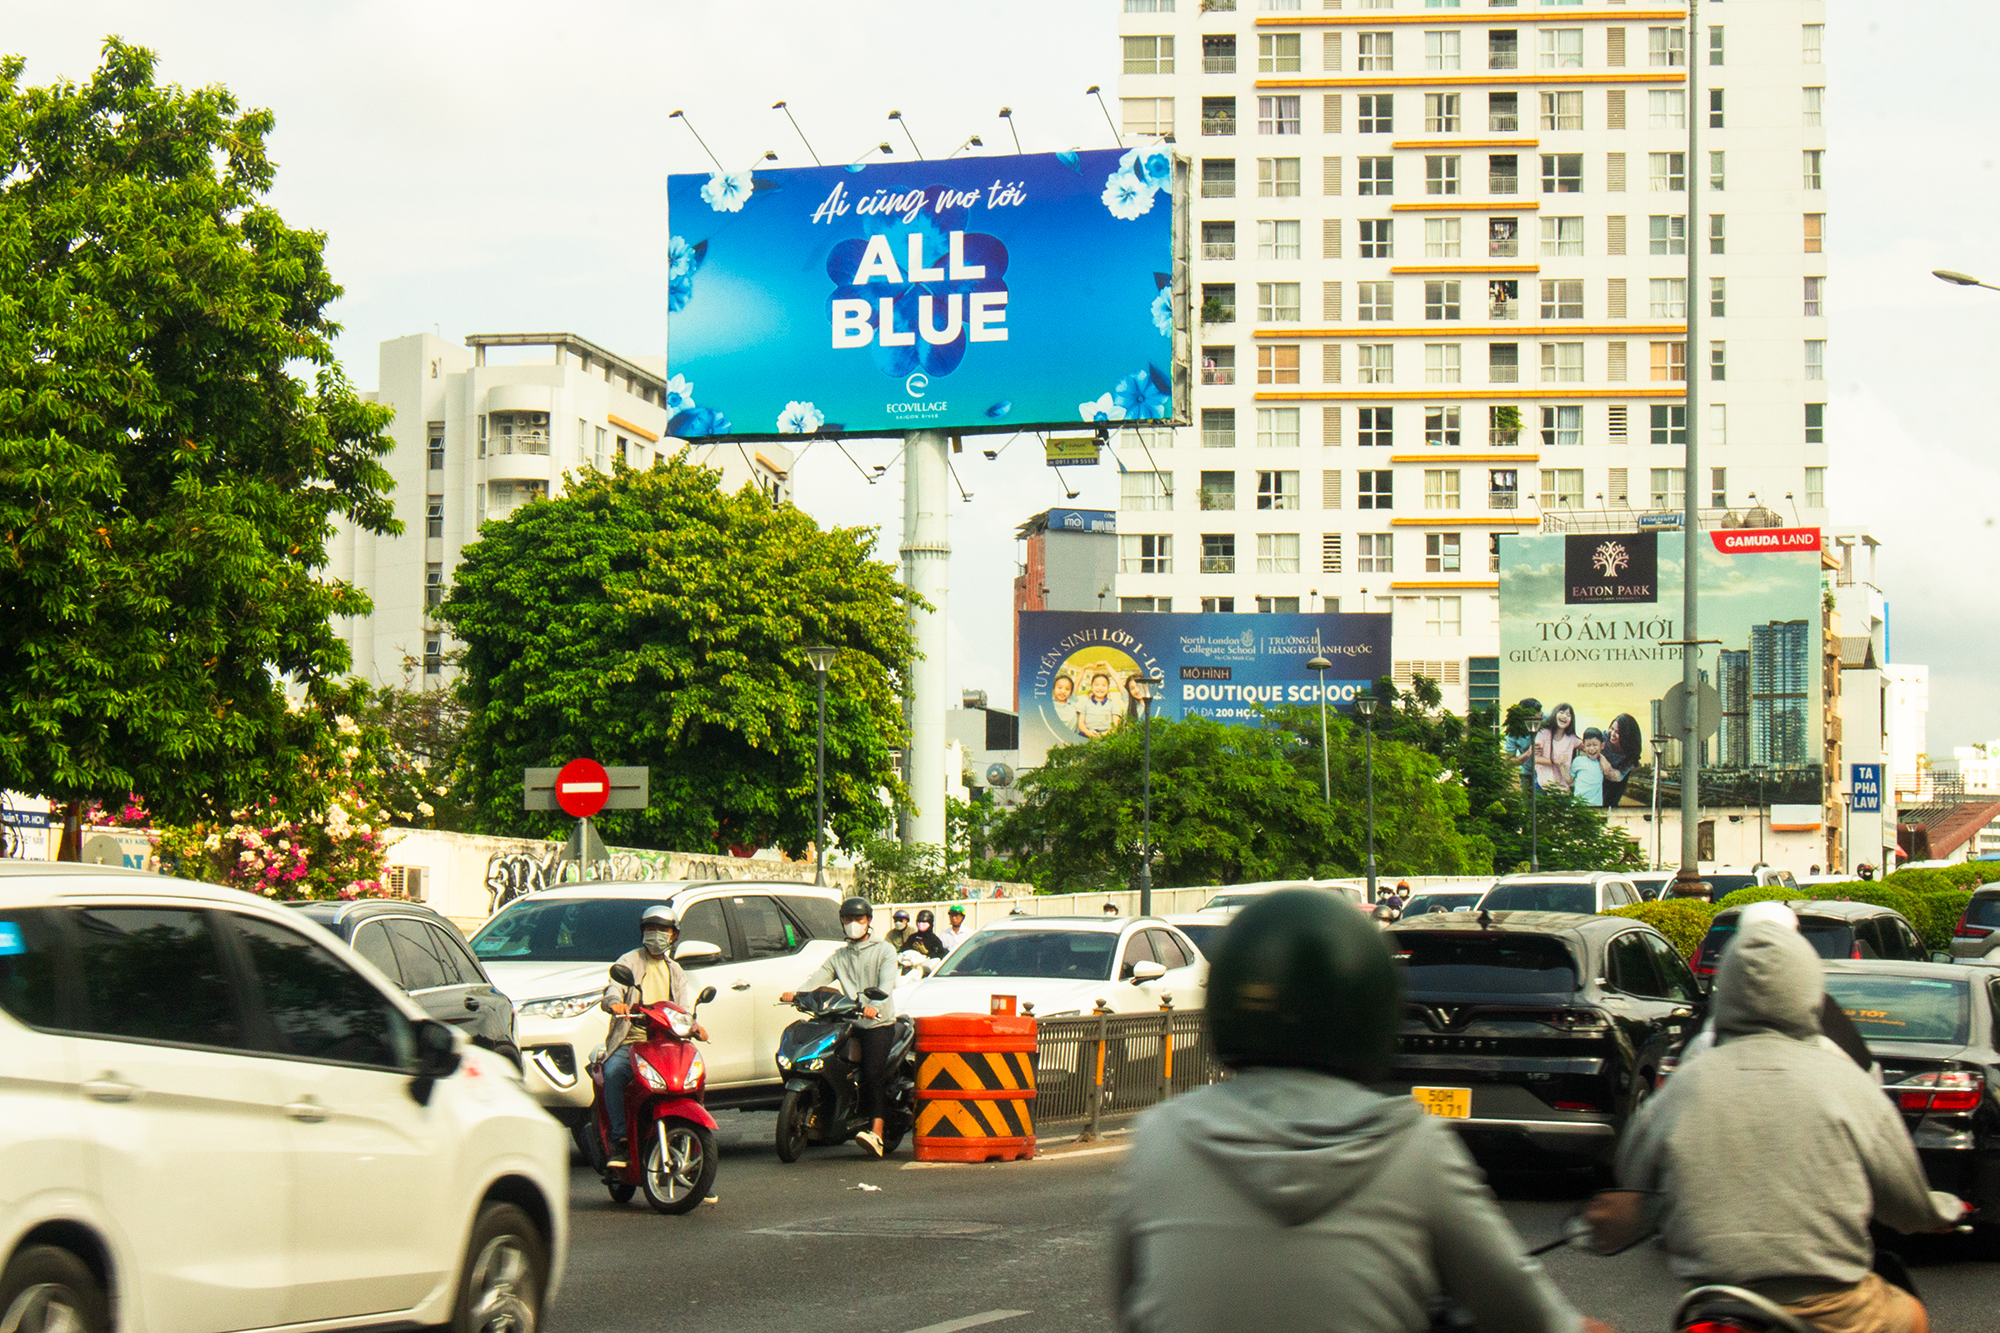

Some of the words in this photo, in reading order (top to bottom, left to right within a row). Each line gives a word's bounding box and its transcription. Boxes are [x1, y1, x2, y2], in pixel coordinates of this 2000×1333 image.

[810, 181, 850, 225] Ai
[856, 189, 929, 224] cũng
[935, 189, 981, 214] mơ
[988, 179, 1027, 210] tới
[852, 230, 986, 285] ALL
[832, 291, 1009, 349] BLUE
[886, 401, 948, 413] ECOVILLAGE
[1725, 535, 1780, 547] GAMUDA
[1782, 533, 1814, 545] LAND
[1572, 585, 1613, 597] EATON
[1617, 585, 1650, 596] PARK
[1536, 615, 1573, 641] TỔ
[1577, 613, 1616, 640] ẤM
[1623, 615, 1674, 640] MỚI
[1060, 628, 1097, 652] SINH
[1102, 628, 1134, 647] LỚP
[1180, 636, 1206, 645] North
[1208, 636, 1240, 645] London
[1268, 635, 1309, 645] TRƯỜNG
[1182, 645, 1225, 656] Collegiate
[1227, 645, 1256, 654] School
[1268, 644, 1297, 654] HÀNG
[1320, 645, 1341, 653] ANH
[1343, 643, 1373, 657] QUỐC
[1509, 648, 1550, 663] GIỮA
[1554, 646, 1600, 662] LÒNG
[1603, 646, 1664, 661] THÀNH
[1183, 668, 1200, 678] MÔ
[1202, 667, 1229, 679] HÌNH
[1577, 681, 1634, 690] eatonpark.com.vn
[1183, 685, 1283, 704] BOUTIQUE
[1201, 707, 1214, 716] ĐA
[1215, 708, 1234, 717] 200
[1859, 767, 1873, 779] TA
[1854, 782, 1877, 794] PHA
[1854, 797, 1878, 809] LAW
